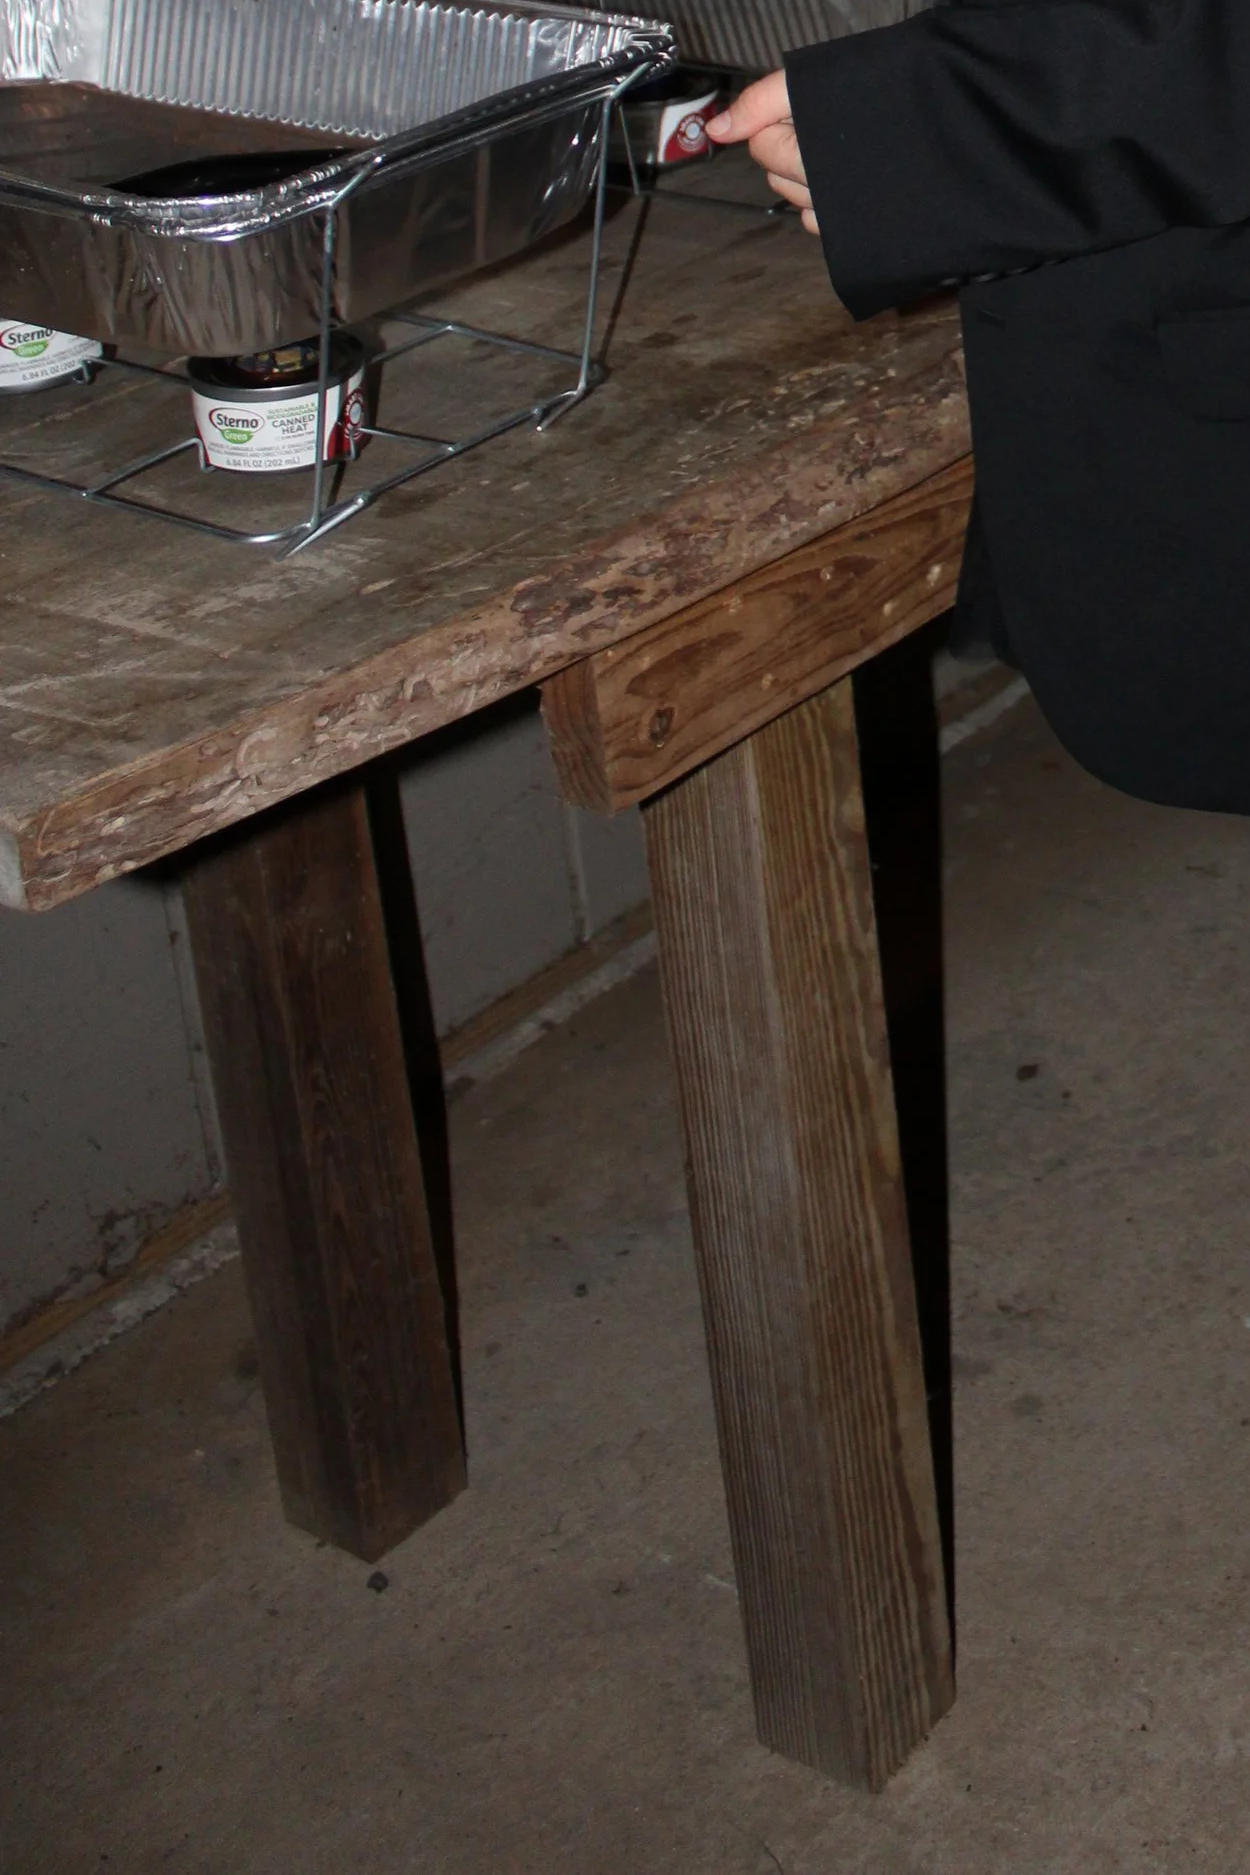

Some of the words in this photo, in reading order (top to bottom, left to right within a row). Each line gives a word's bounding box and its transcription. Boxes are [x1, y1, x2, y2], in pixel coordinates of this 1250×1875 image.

[8, 328, 53, 345] Sterno
[216, 413, 259, 429] Sterno
[272, 413, 316, 428] CANNED
[282, 423, 308, 435] HEAT
[224, 430, 248, 442] Green
[243, 459, 252, 468] FL
[252, 459, 263, 468] OZ
[264, 458, 283, 468] (202
